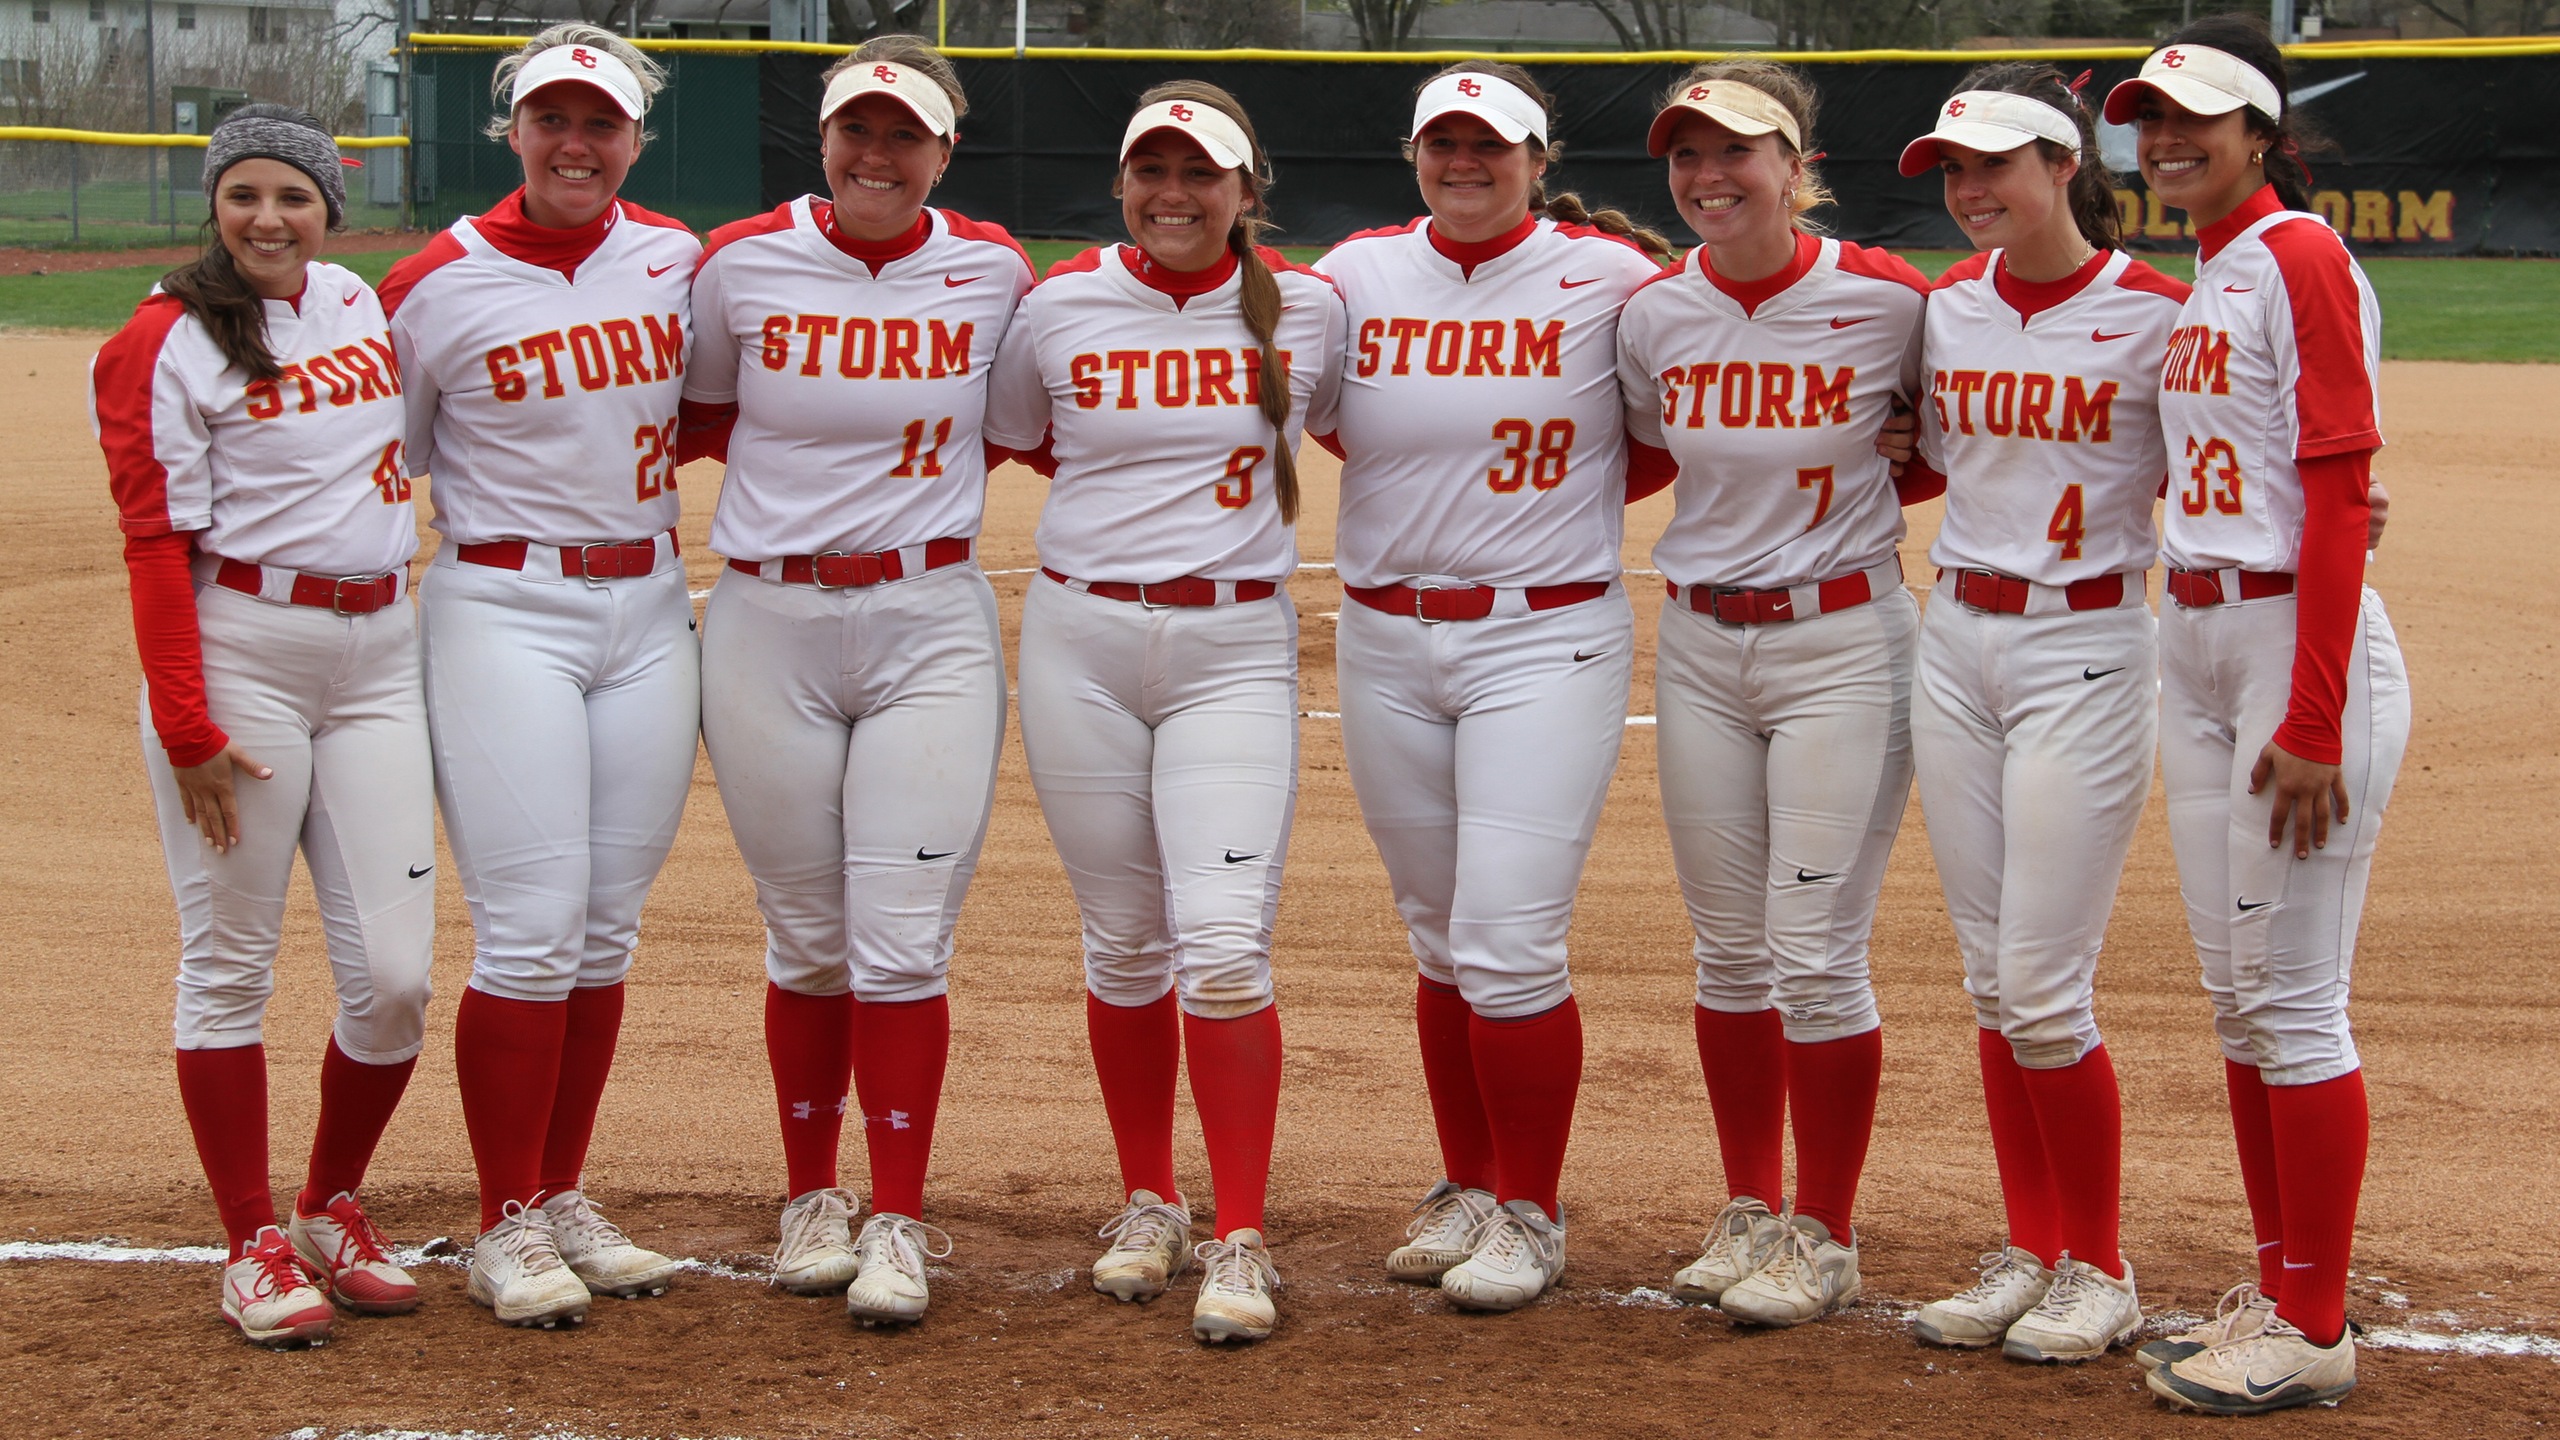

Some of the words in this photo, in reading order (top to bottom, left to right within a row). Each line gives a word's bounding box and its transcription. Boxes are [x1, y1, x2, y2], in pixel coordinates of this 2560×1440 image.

[572, 48, 597, 69] SC
[873, 65, 897, 84] SC
[1457, 78, 1481, 98] SC
[2161, 49, 2186, 68] SC
[1169, 104, 1193, 122] SC
[1946, 99, 1966, 118] SC
[2310, 190, 2457, 242] ORM
[485, 312, 686, 403] STORM
[761, 314, 974, 380] STORM
[1356, 317, 1566, 378] STORM
[2161, 325, 2233, 396] TORM
[1660, 360, 1855, 429] STORM
[1930, 369, 2120, 443] STORM
[889, 416, 953, 478] 11
[1215, 445, 1267, 509] 9
[1486, 418, 1576, 494] 38
[2182, 434, 2243, 517] 33
[1796, 464, 1835, 532] 7
[2046, 483, 2086, 561] 4
